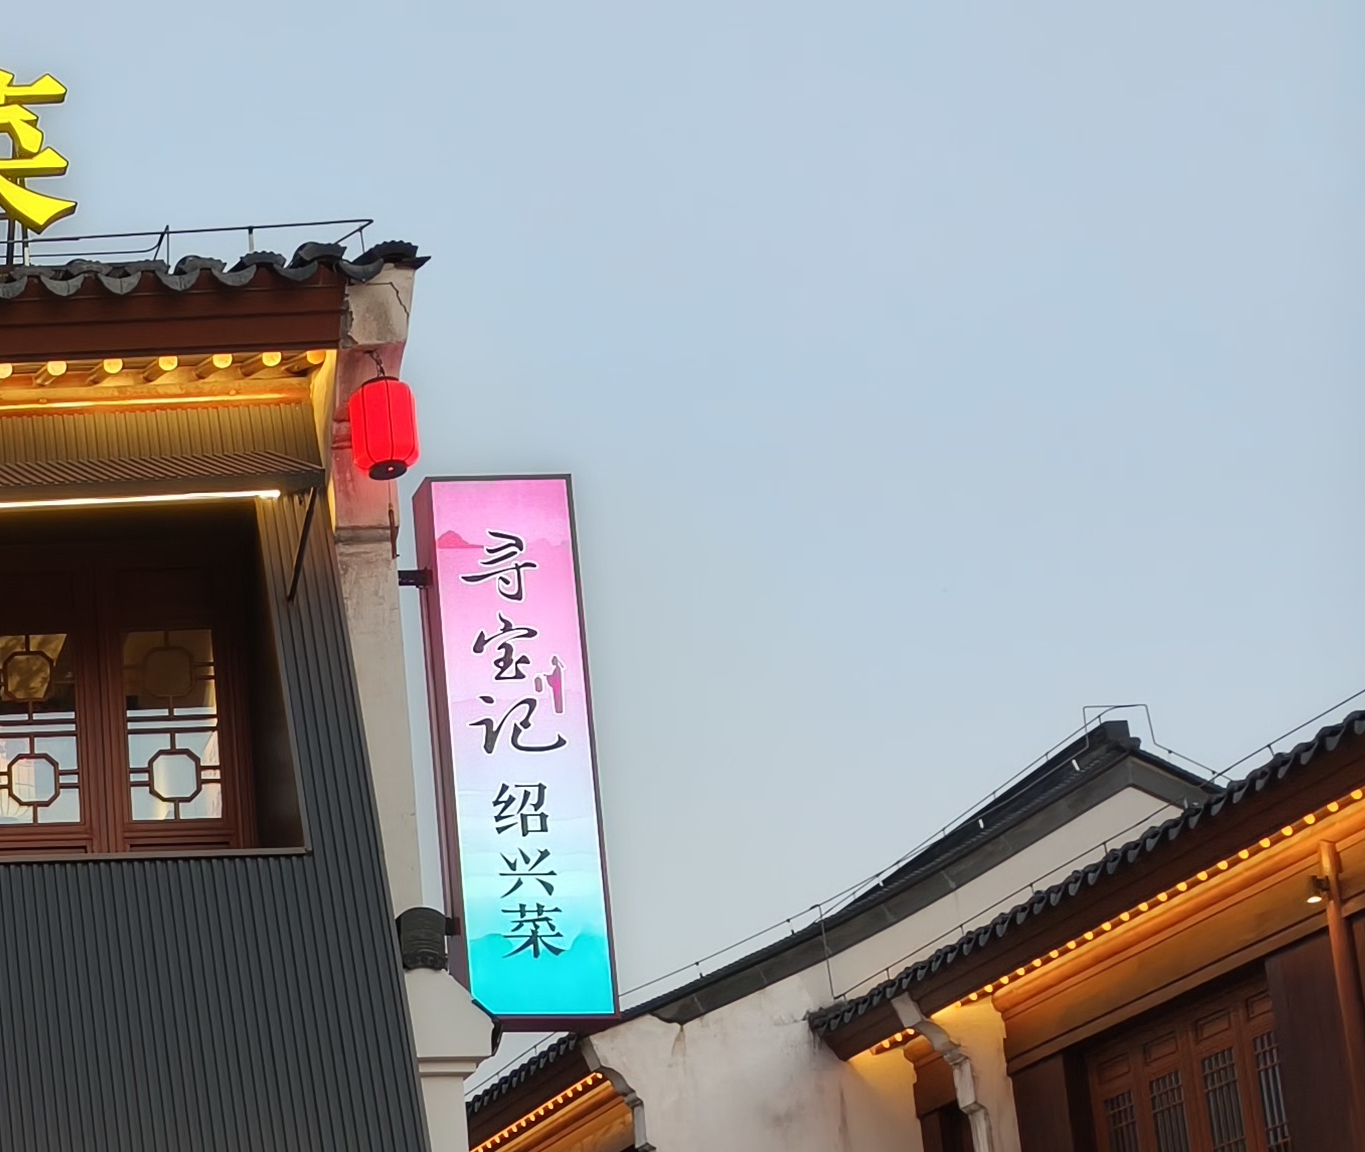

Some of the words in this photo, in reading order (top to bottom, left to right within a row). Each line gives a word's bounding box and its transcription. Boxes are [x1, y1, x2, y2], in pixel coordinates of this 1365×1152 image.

[461, 530, 567, 754] 寻宝记
[492, 782, 565, 958] 绍兴菜
